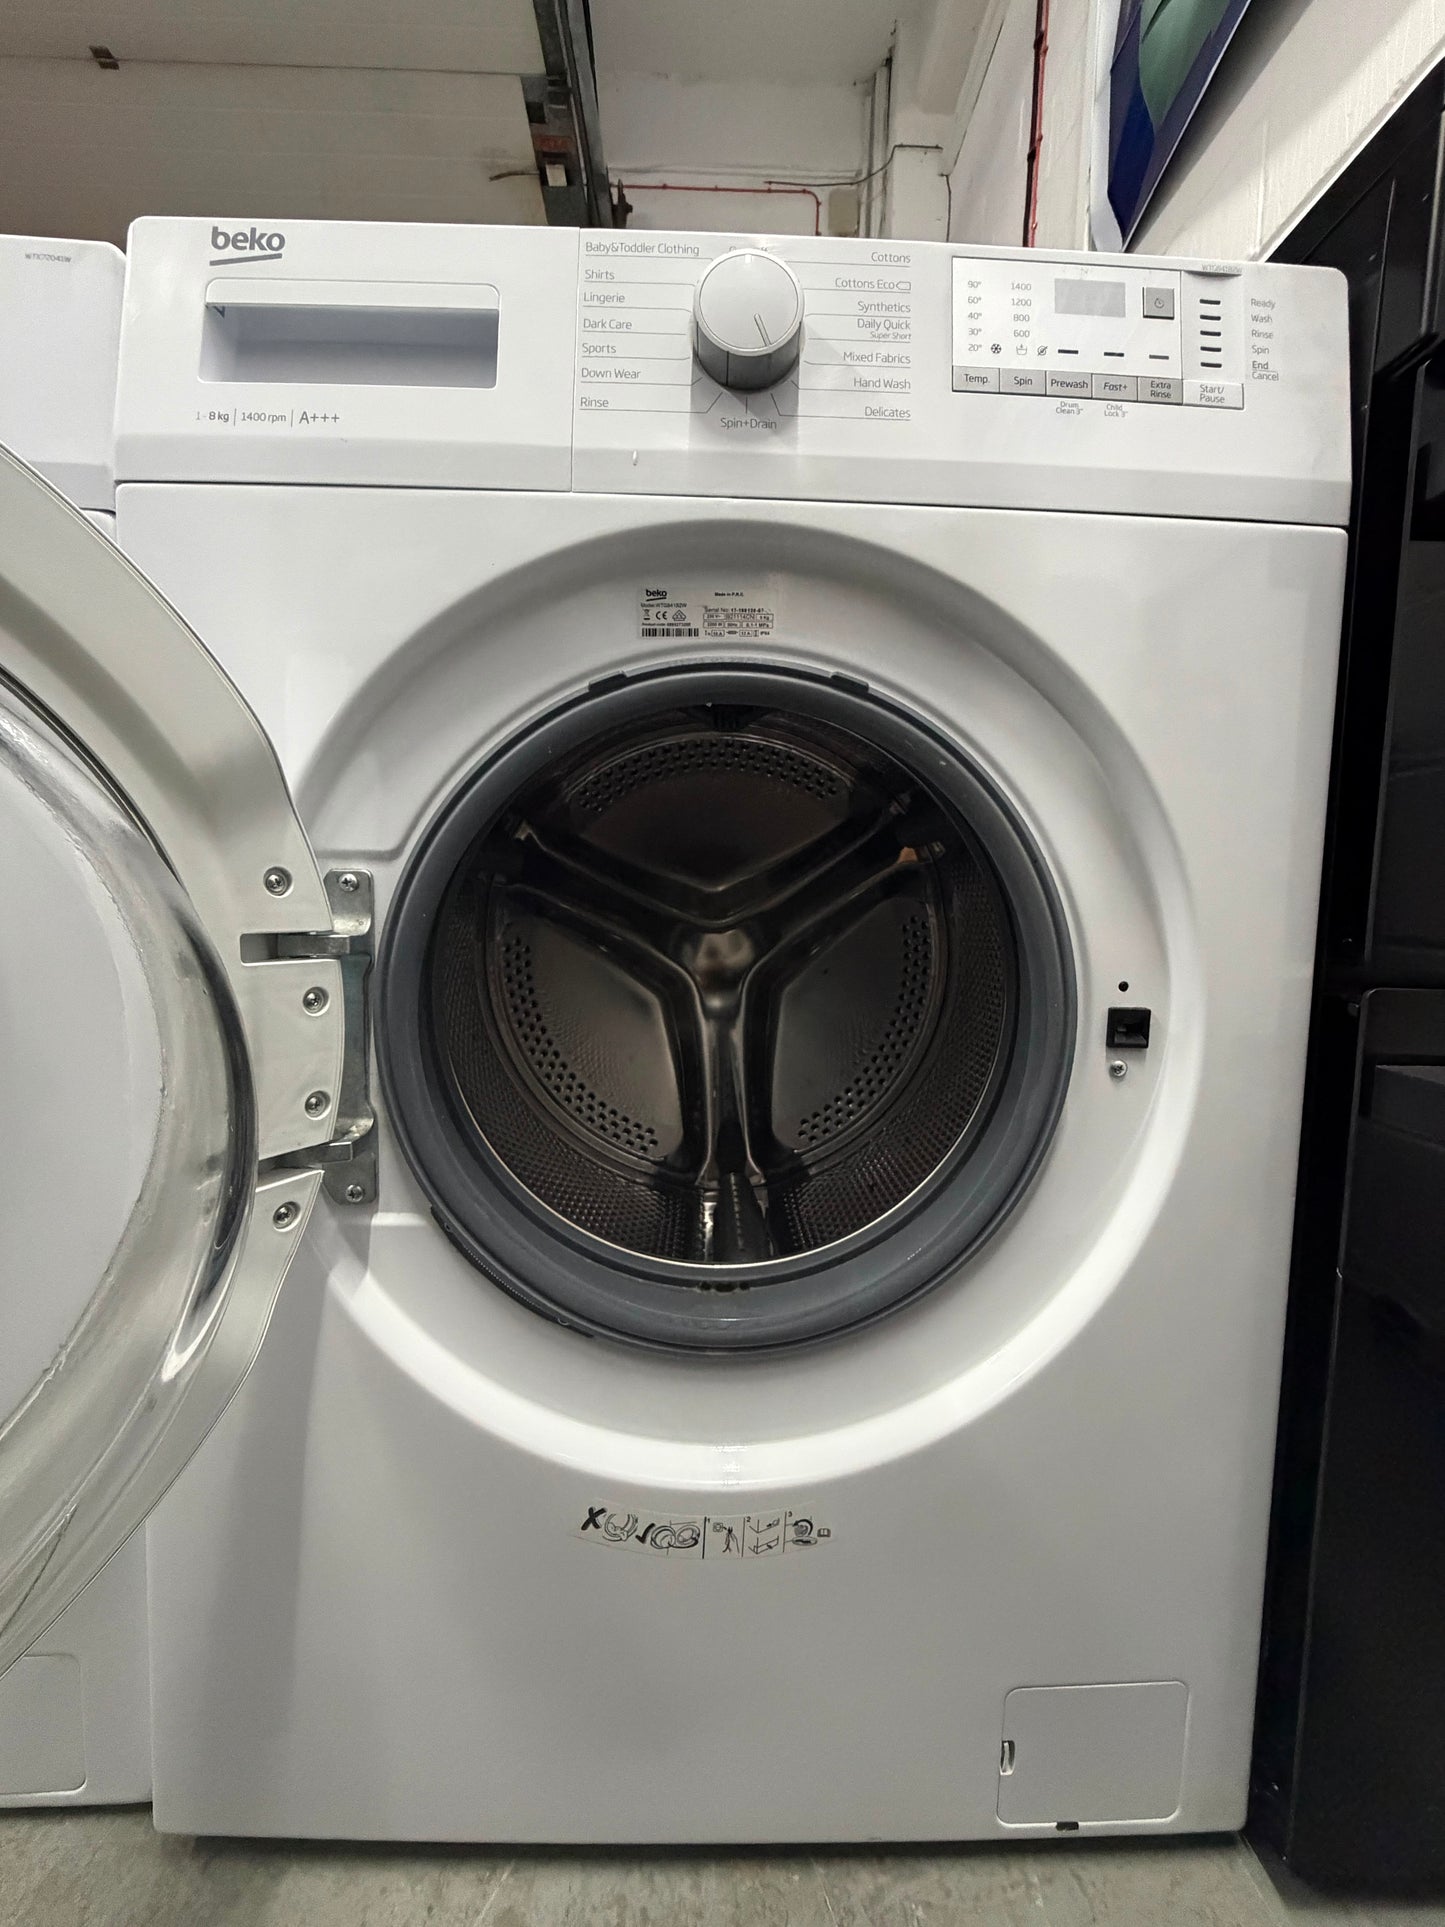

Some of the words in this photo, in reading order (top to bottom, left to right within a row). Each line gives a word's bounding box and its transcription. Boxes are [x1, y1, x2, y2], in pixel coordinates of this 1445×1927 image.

[211, 226, 286, 252] beko
[585, 242, 655, 254] Baby&Toddler
[657, 243, 700, 256] Clothing
[871, 251, 911, 263] Cottons
[584, 269, 616, 280] Shirts
[835, 277, 875, 289] Cottons
[877, 280, 895, 290] Eco
[1011, 282, 1032, 291] 1400
[583, 292, 625, 305] Lingerie
[1011, 298, 1032, 307] 1200
[1250, 298, 1276, 310] Ready
[857, 301, 911, 313] Synthetics
[1013, 313, 1030, 322] 800
[1251, 313, 1273, 323] Wash
[583, 318, 607, 329] Dark
[608, 319, 632, 330] Care
[857, 318, 881, 331] Daily
[883, 319, 911, 331] Quick
[870, 331, 891, 342] Super
[892, 331, 911, 340] Short
[1013, 329, 1030, 338] 600
[1251, 329, 1274, 339] Rinse
[582, 343, 616, 354] Sports
[1251, 345, 1270, 355] Spin
[843, 351, 874, 363] Mixed
[875, 353, 911, 364] Fabrics
[1252, 360, 1269, 370] End
[581, 367, 612, 378] Down
[614, 368, 641, 379] Wear
[1252, 371, 1279, 381] Cancel
[853, 378, 881, 389] Hand
[882, 379, 911, 390] Wash
[1013, 376, 1033, 387] Spin
[1051, 378, 1089, 389] Prewash
[1103, 382, 1128, 392] Fast+
[1150, 380, 1171, 390] Extra
[1150, 390, 1172, 399] Rinse
[1200, 384, 1225, 394] Start/
[580, 397, 609, 408] Rinse
[1200, 394, 1225, 404] Pause
[864, 406, 911, 418] Delicates
[1056, 407, 1075, 415] Clean
[1106, 403, 1123, 411] Child
[241, 412, 267, 422] 1400
[267, 414, 287, 424] rpm
[299, 411, 340, 424] A+++
[1104, 410, 1120, 418] Lock
[720, 418, 777, 430] Spin+Drain
[645, 589, 668, 598] beko
